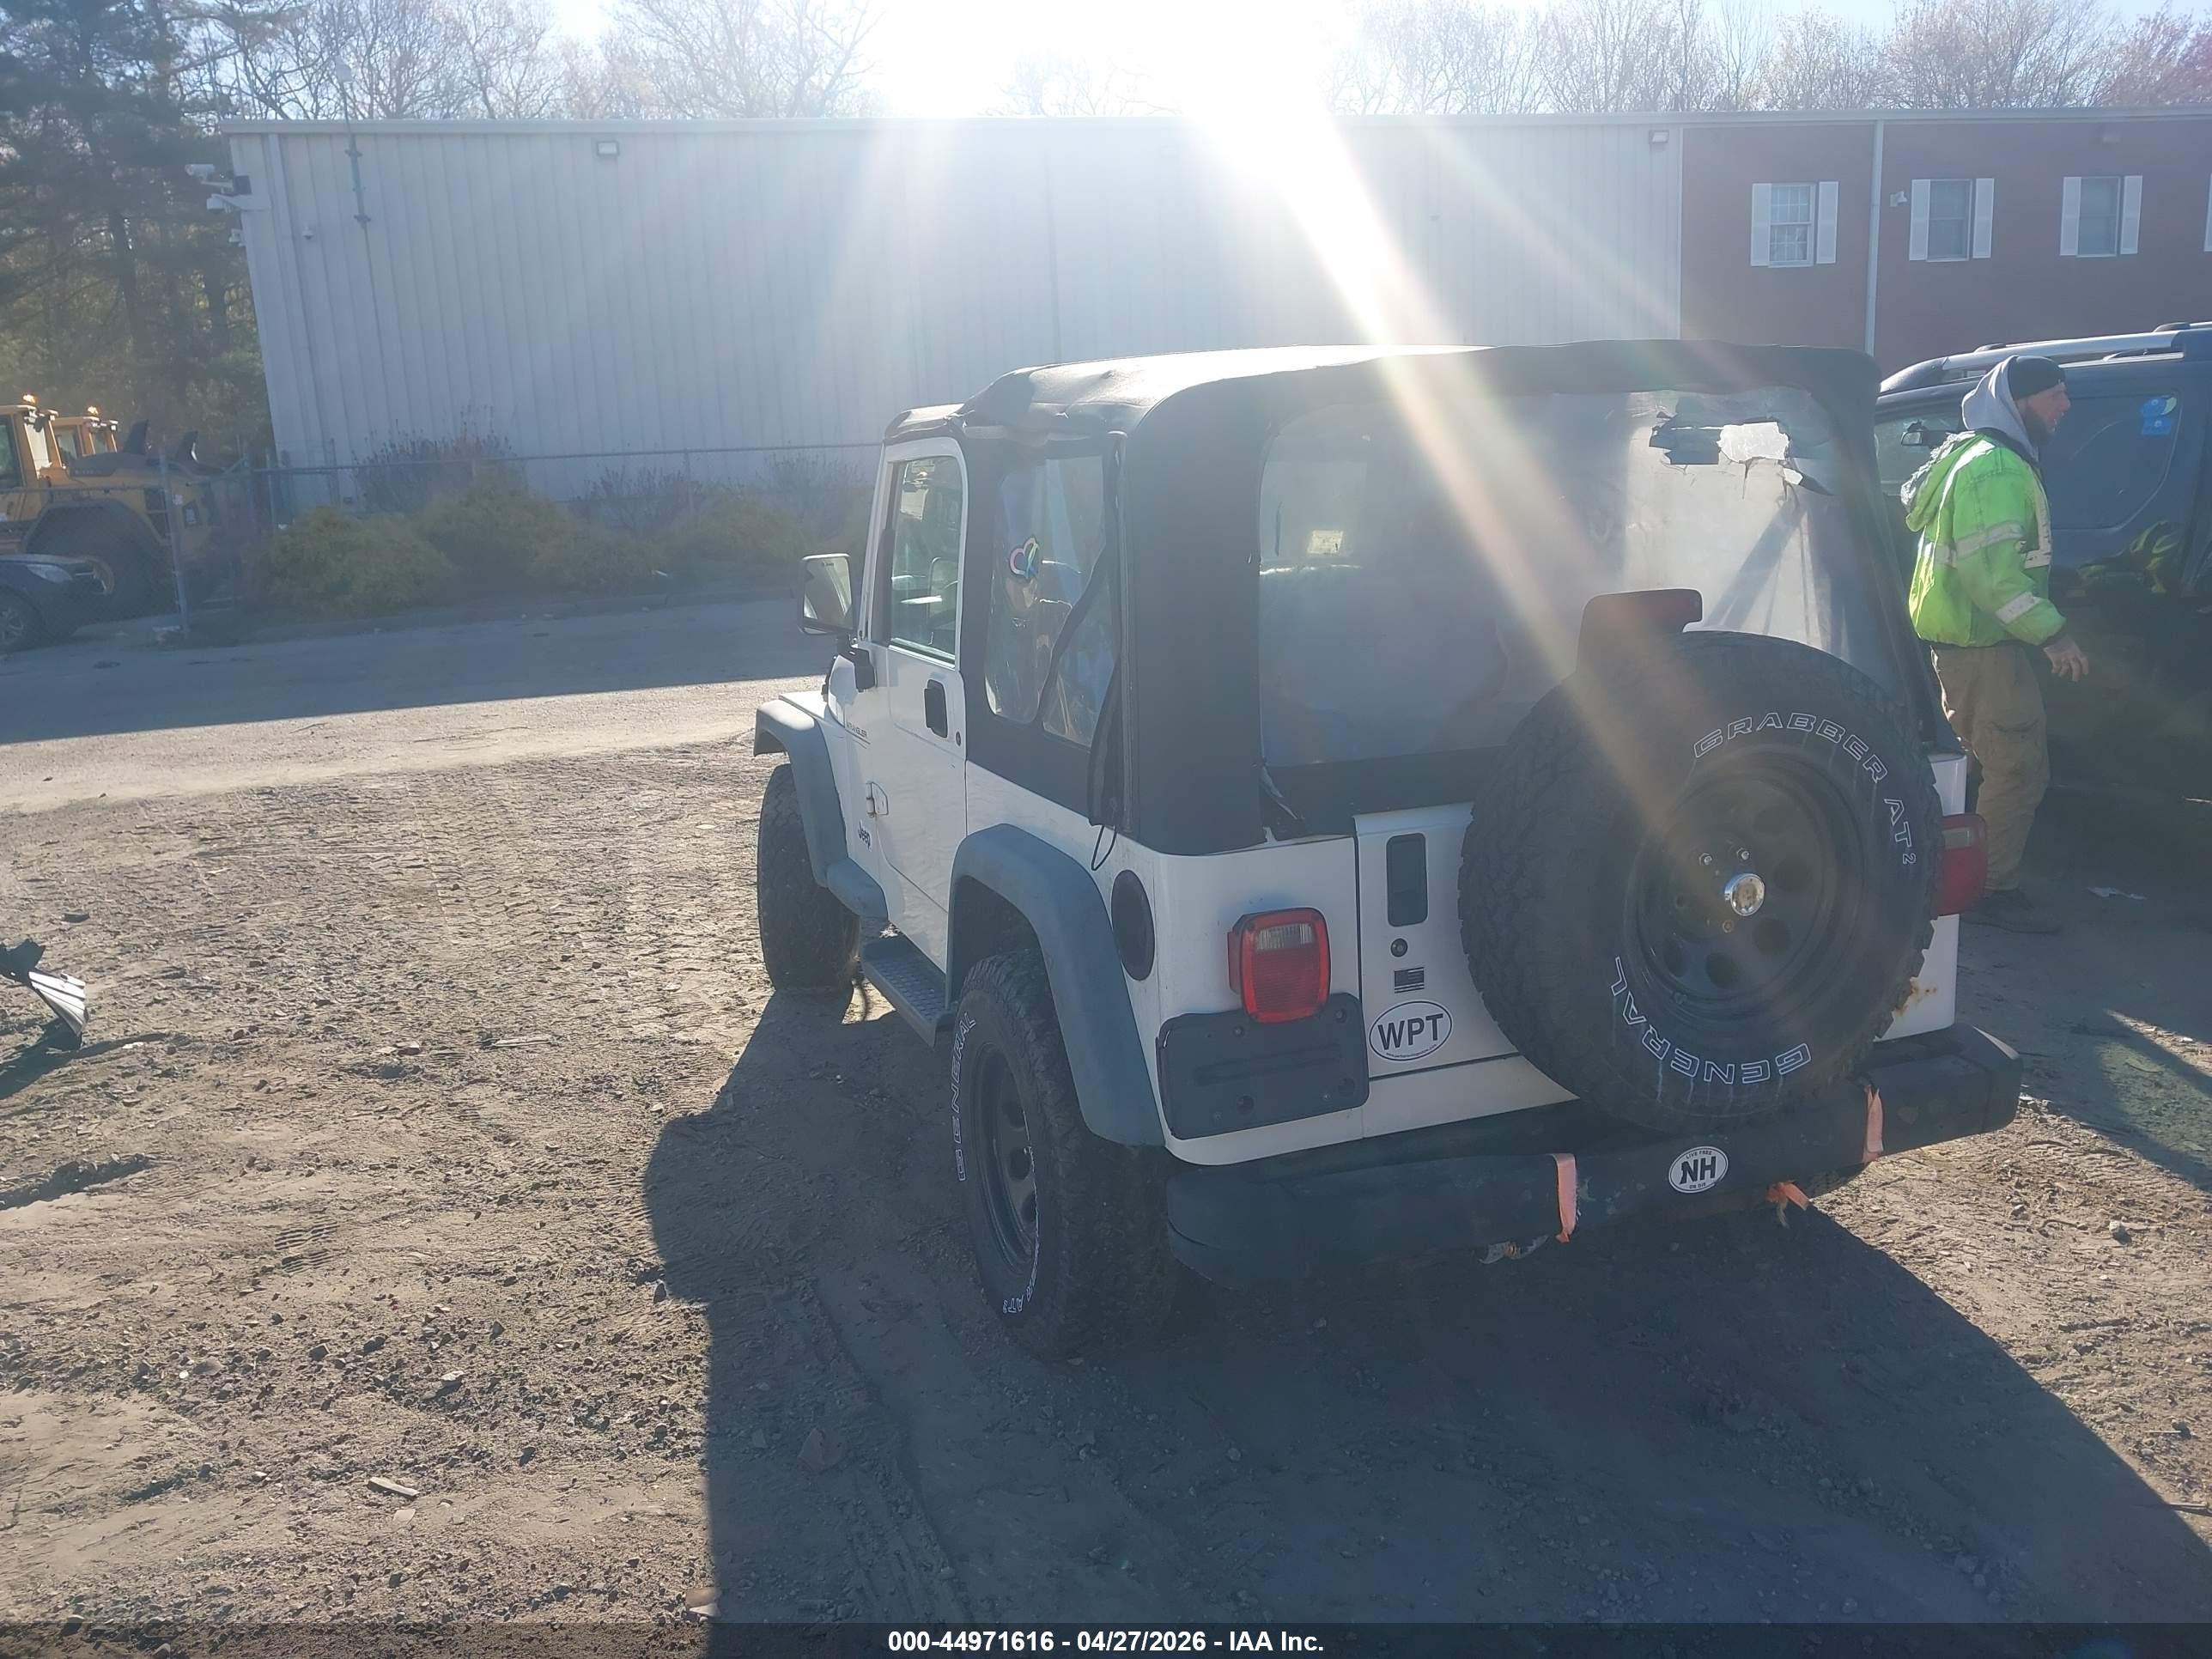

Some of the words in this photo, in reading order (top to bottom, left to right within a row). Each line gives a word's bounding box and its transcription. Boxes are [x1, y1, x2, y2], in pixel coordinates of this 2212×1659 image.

[1693, 712, 1889, 783] GRABBER
[1377, 1013, 1443, 1051] WPT
[1610, 956, 1813, 1085] GENERAL
[951, 1012, 976, 1182] GENERAL
[1679, 1156, 1717, 1185] NH
[1686, 1151, 1698, 1159] LIVE
